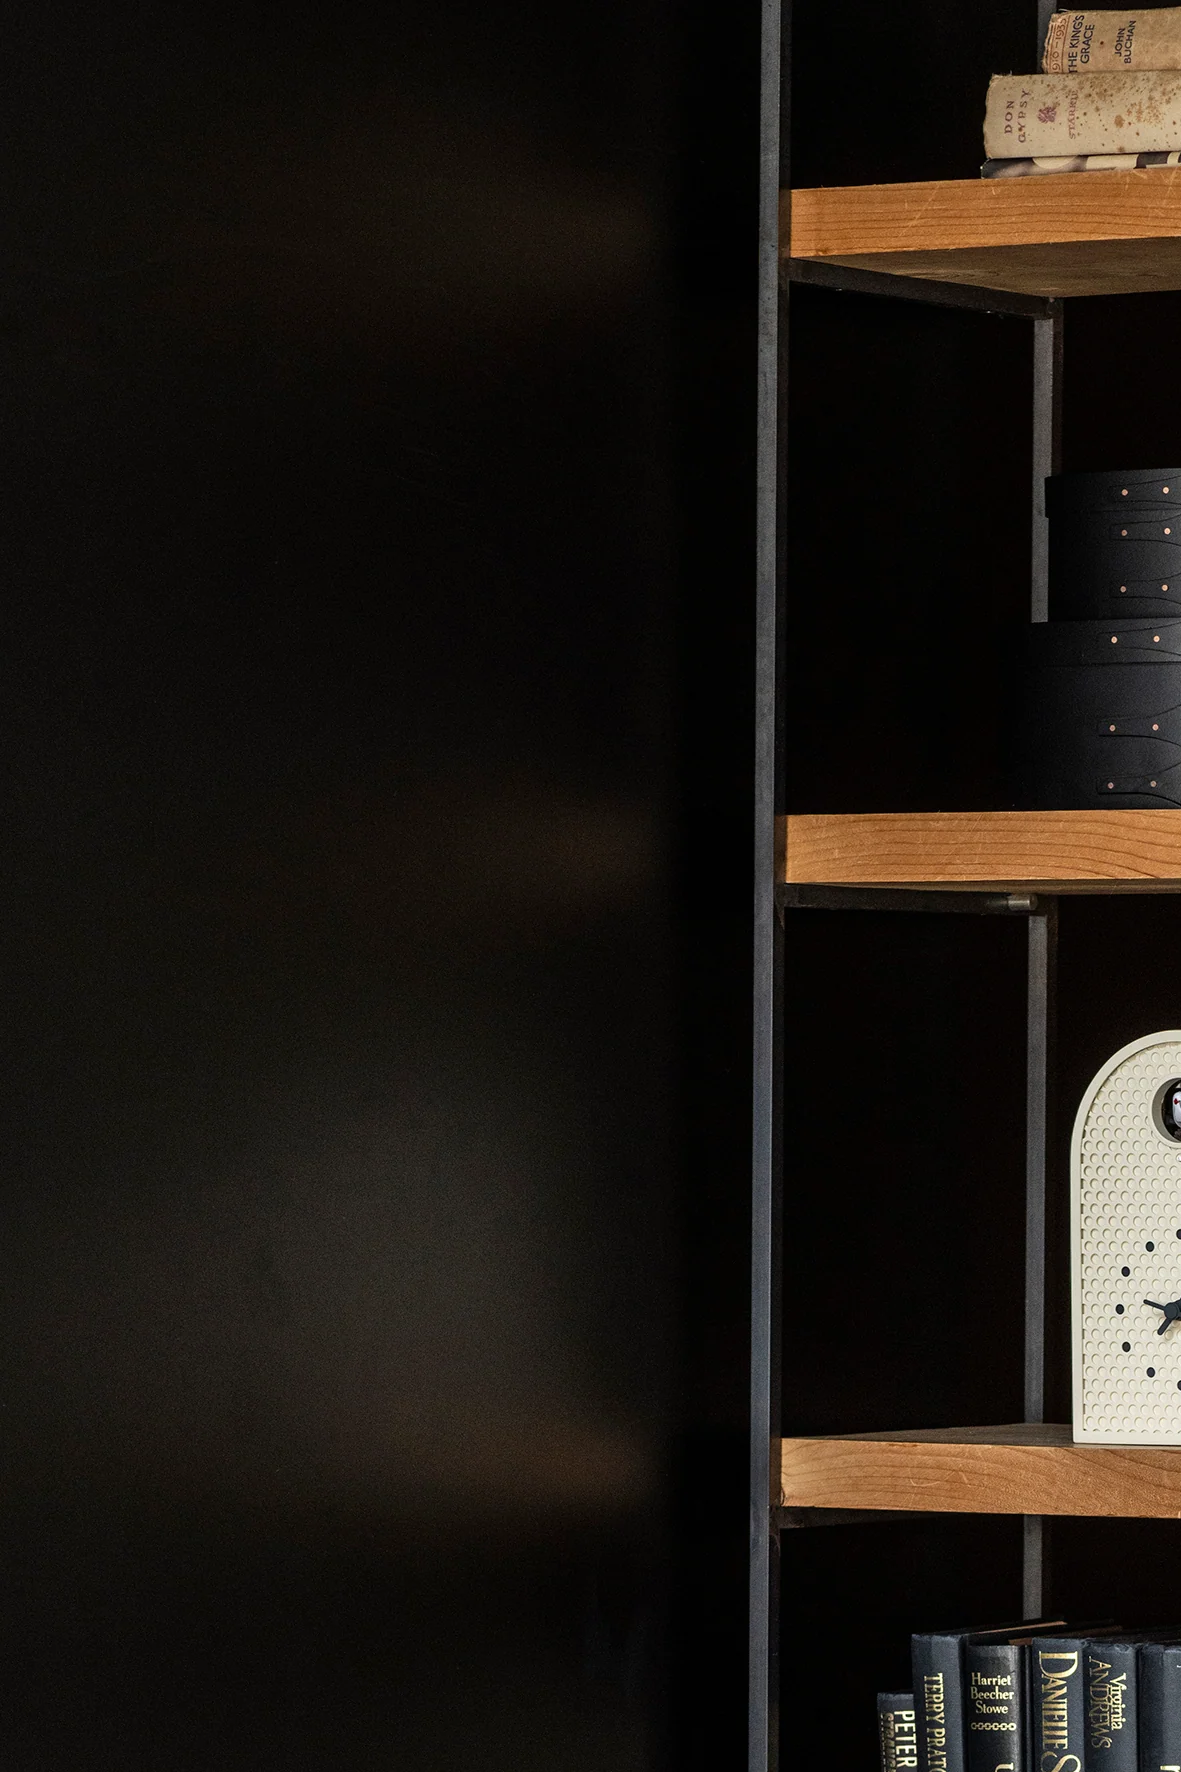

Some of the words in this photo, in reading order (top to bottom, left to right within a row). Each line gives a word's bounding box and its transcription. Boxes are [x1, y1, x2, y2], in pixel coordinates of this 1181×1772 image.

[1071, 15, 1084, 48] KING'S
[1081, 24, 1095, 64] GRACE
[1115, 28, 1126, 57] JOHN
[1124, 20, 1136, 64] BUCHAN
[1068, 52, 1077, 73] THE
[1005, 100, 1015, 134] DON
[1018, 88, 1031, 143] GYPSY
[924, 1673, 945, 1724] TERRY
[971, 1672, 1012, 1686] Harriet
[971, 1686, 1015, 1700] Beecher
[976, 1700, 1009, 1714] Stowe
[1039, 1651, 1078, 1750] DANIELLE
[1089, 1655, 1112, 1749] ANDREWS
[1109, 1673, 1127, 1731] Virginia
[894, 1710, 918, 1768] PETER
